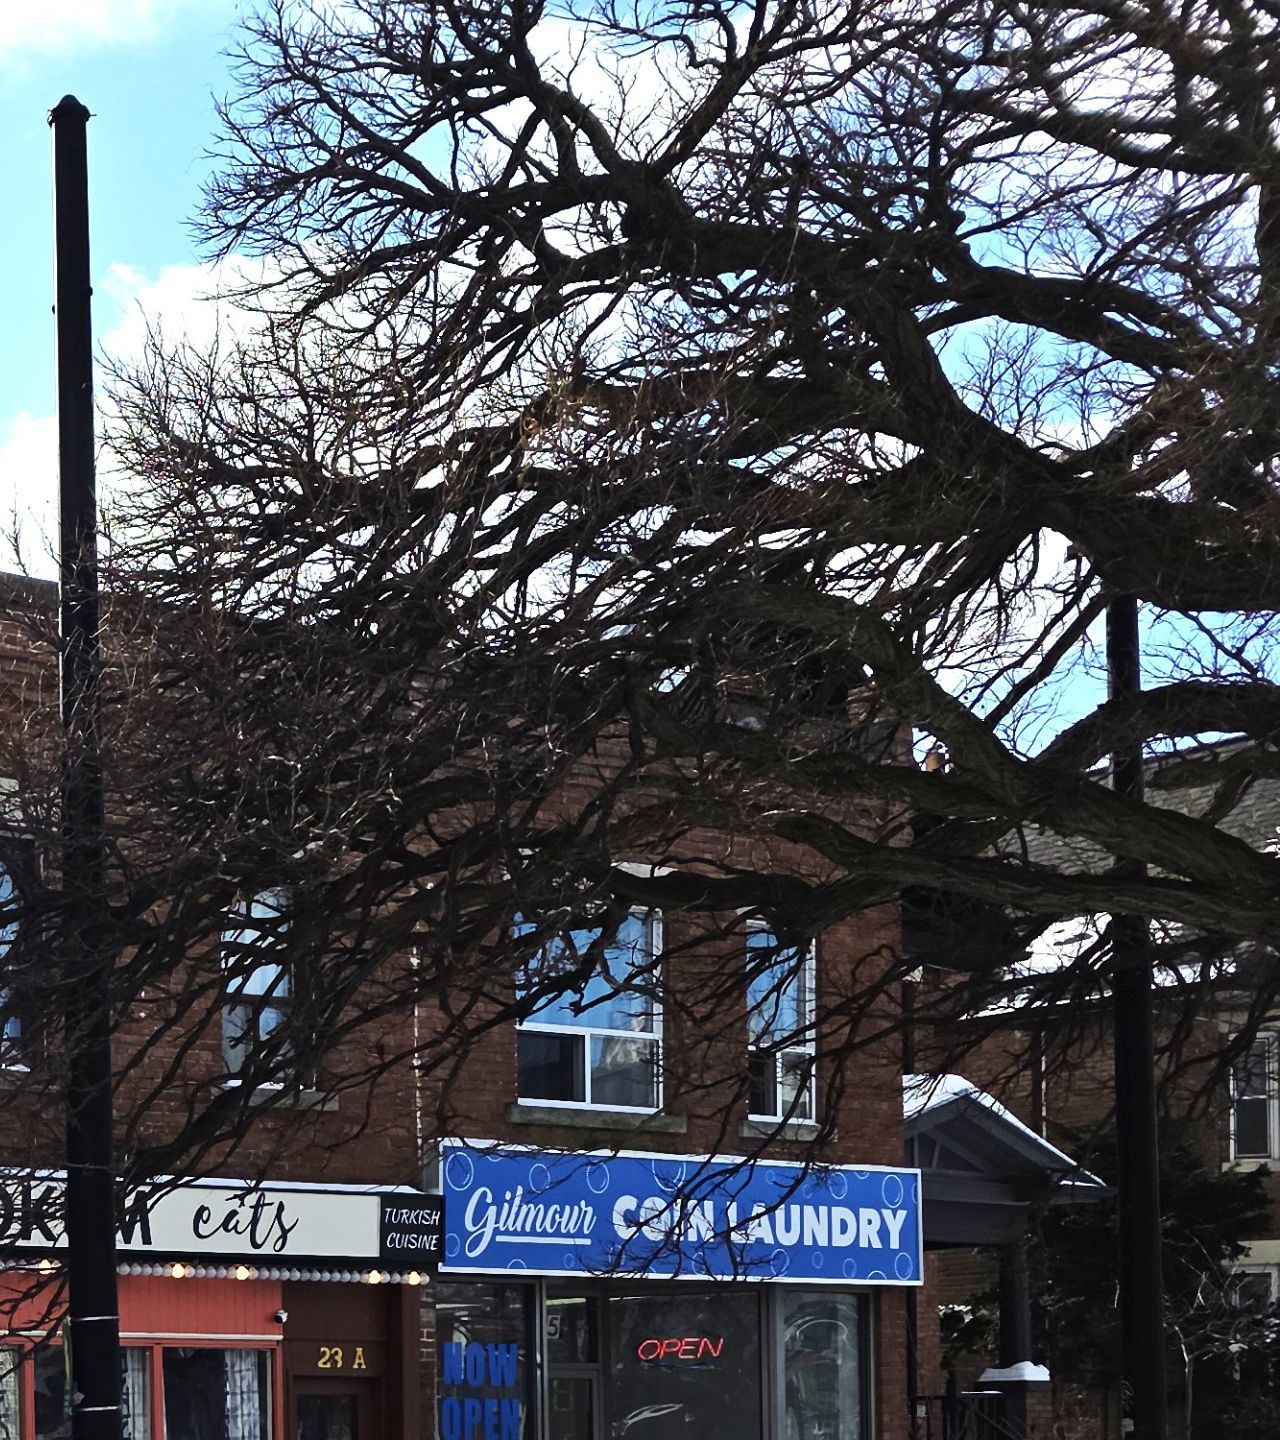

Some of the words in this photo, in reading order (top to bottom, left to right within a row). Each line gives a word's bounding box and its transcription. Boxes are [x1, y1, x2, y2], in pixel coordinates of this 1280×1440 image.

[192, 1191, 299, 1253] eats
[384, 1207, 441, 1226] TURKISH
[464, 1185, 597, 1258] Gilmour
[612, 1194, 715, 1242] COIN
[726, 1200, 908, 1250] LAUNDRY
[386, 1232, 440, 1250] CUISINE
[317, 1346, 343, 1369] 23
[352, 1347, 367, 1369] A
[637, 1336, 724, 1361] OPEN
[442, 1341, 518, 1388] NOW
